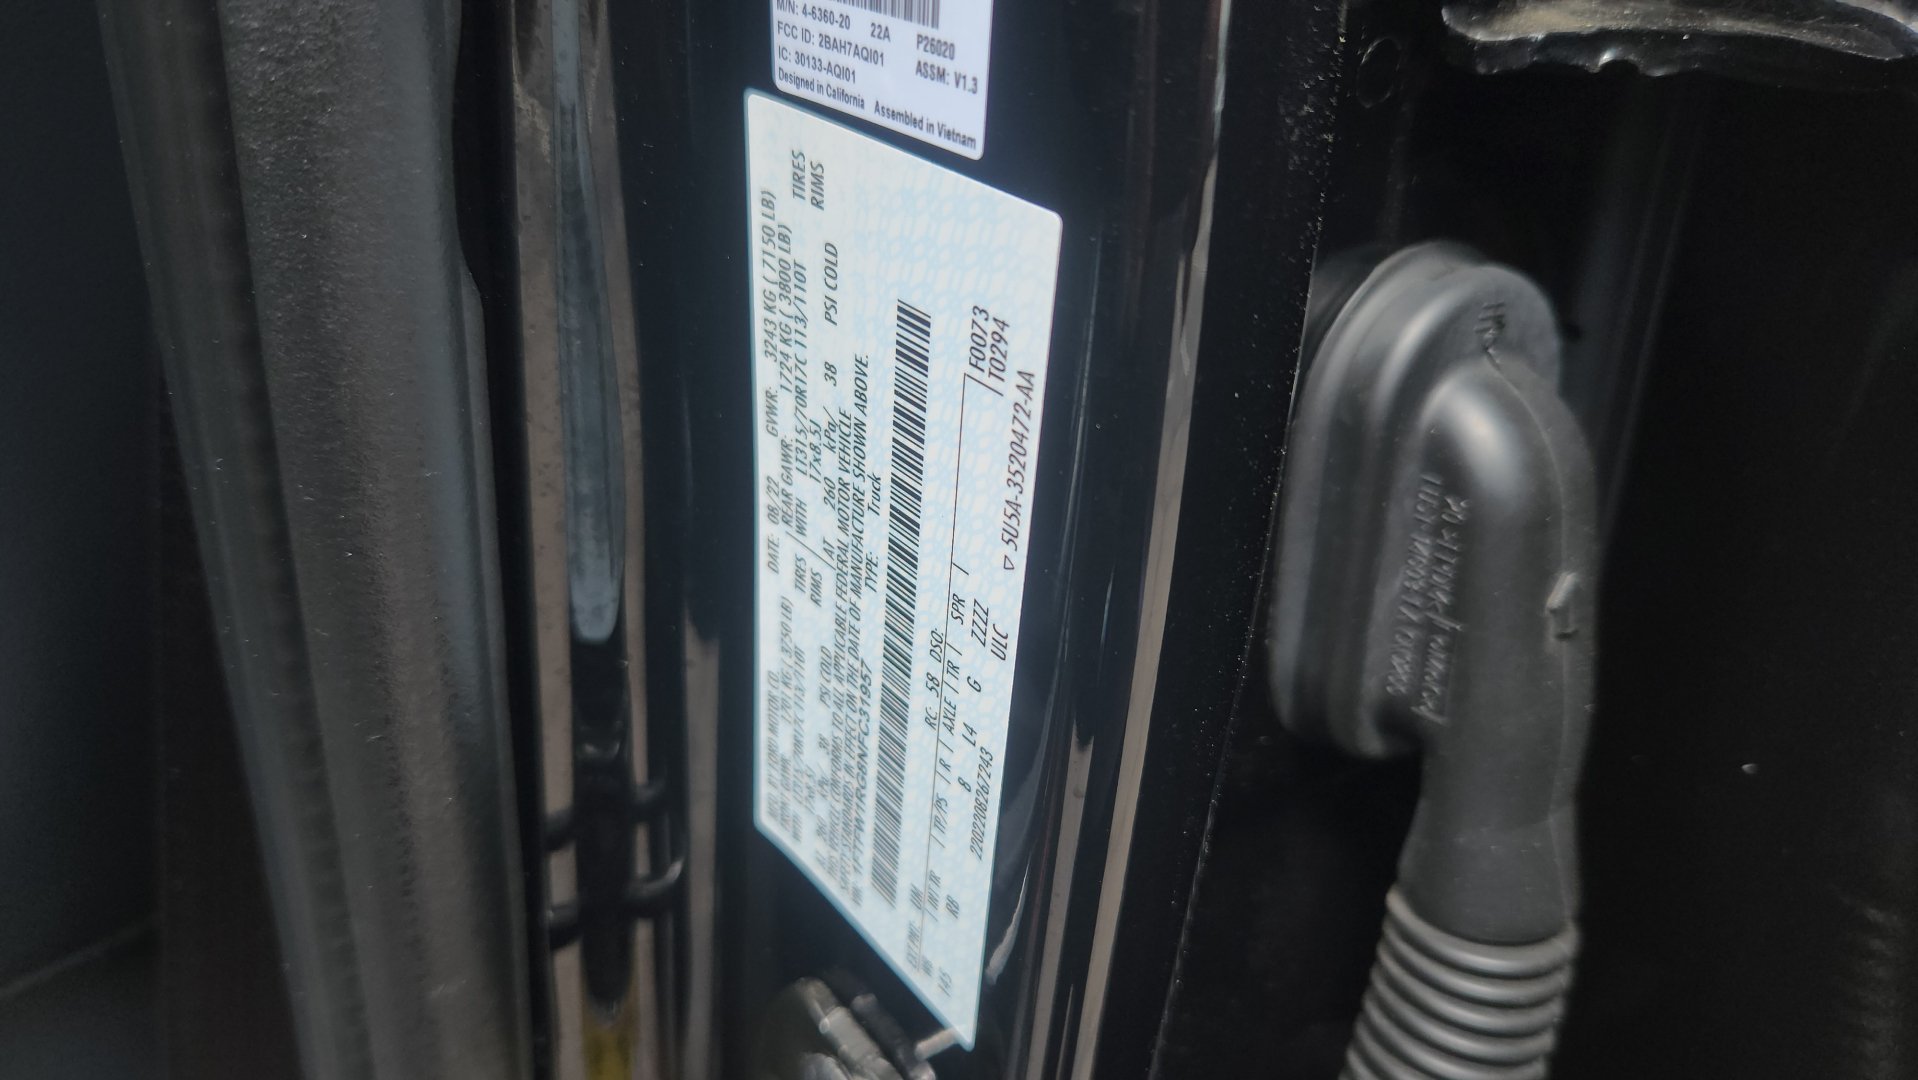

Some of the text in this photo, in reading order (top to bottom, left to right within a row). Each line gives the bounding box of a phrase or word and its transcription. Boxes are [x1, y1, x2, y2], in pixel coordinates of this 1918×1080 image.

[776, 0, 851, 30] M/N: 4-6360-20
[869, 22, 891, 42] 22A
[777, 21, 885, 67] FCC ID: 2BAH7AQI01
[916, 34, 956, 61] P26020
[778, 45, 856, 84] IC: 30133-AQI01
[915, 60, 978, 94] ASSM: V1.3
[778, 67, 977, 150] Designed in California Assembled in Vietnam
[761, 188, 776, 221] LB)
[761, 225, 776, 272] 7150
[777, 224, 792, 254] LB)
[763, 289, 776, 315] KG
[778, 259, 791, 306] 3800
[764, 319, 777, 363] 3243
[779, 323, 792, 347] KG
[810, 161, 824, 483] 17x8.5J RIMS
[969, 305, 989, 373] F0073
[792, 149, 808, 537] WITH LT315/70R17C 113/110T TIRES
[988, 316, 1010, 382] T0294
[780, 349, 792, 393] 1724
[854, 354, 868, 416] ABOVE.
[765, 387, 778, 438] GVWR:
[823, 242, 838, 560] AT 260 kPa/ 38 PSI COLD
[839, 407, 852, 474] VEHICLE
[853, 417, 866, 481] SHOWN
[781, 435, 793, 486] GAWR:
[1001, 370, 1035, 552] 5U5A-3520472-AA
[767, 475, 781, 574] DATE: 08/22
[781, 488, 793, 527] REAR
[837, 475, 850, 536] MOTOR
[851, 482, 865, 599] MANUFACTURE
[865, 472, 881, 593] TYPE: Truck
[795, 554, 806, 594] TIRES
[811, 568, 822, 607] RIMS
[836, 539, 849, 602] FEDERAL
[850, 600, 861, 621] OF
[951, 593, 965, 625] SPR
[971, 598, 988, 647] ZZZZ
[781, 621, 792, 658] 3750
[833, 601, 847, 680] APPLICABLE
[848, 623, 860, 659] DATE
[991, 623, 1008, 661] ULC
[782, 670, 792, 688] KG
[820, 646, 832, 683] COLD
[847, 660, 858, 689] THE
[925, 627, 943, 730] RC: 58 DSO:
[947, 660, 959, 680] TR
[967, 676, 981, 692] G
[768, 688, 779, 737] MOTOR
[820, 685, 831, 708] PSI
[833, 681, 844, 711] ALL
[847, 688, 858, 713] ON
[832, 712, 843, 731] TO
[942, 697, 957, 735] AXLE
[962, 722, 977, 746] L4
[819, 734, 830, 755] 38
[845, 713, 857, 759] EFFECT
[830, 733, 842, 802] CONFORMS
[844, 761, 855, 778] IN
[939, 759, 950, 771] R
[958, 777, 971, 792] 8
[841, 781, 854, 851] STANDARDS
[934, 792, 947, 834] TP/PS
[970, 746, 993, 860] 2202208267243
[928, 887, 939, 910] INT
[929, 870, 940, 888] TR
[946, 894, 959, 919] RB
